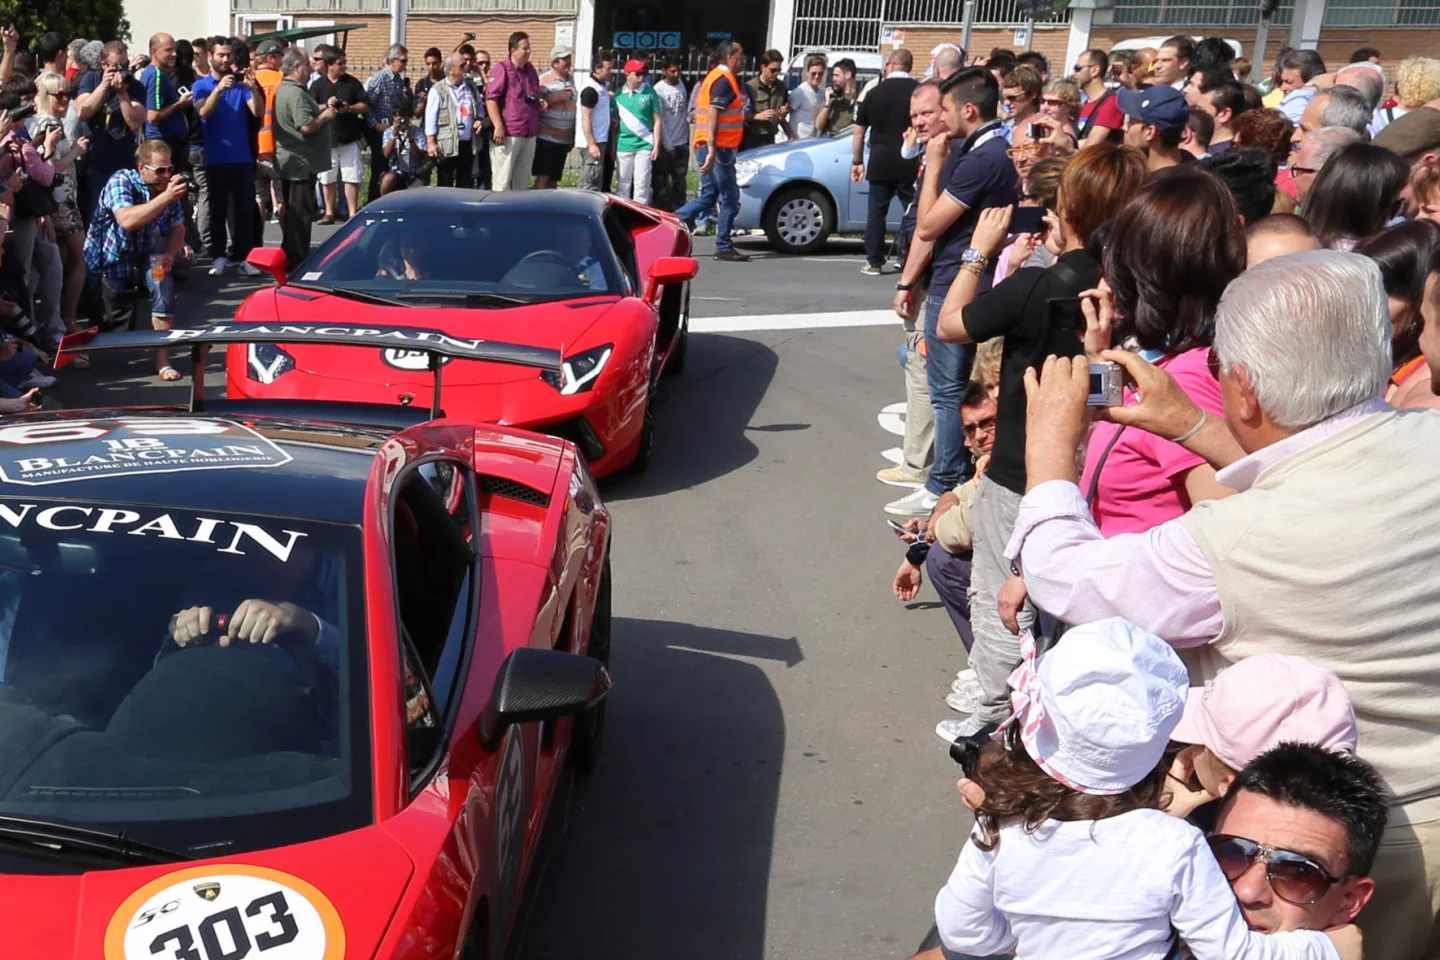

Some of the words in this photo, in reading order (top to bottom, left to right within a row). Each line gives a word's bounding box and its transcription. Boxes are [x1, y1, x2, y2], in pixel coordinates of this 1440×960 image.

[616, 32, 678, 48] COC
[160, 325, 487, 350] BLANCPAIN
[14, 445, 265, 473] BLANCPAIN
[21, 462, 121, 479] MANUFACTURE
[144, 458, 188, 466] HAUTE
